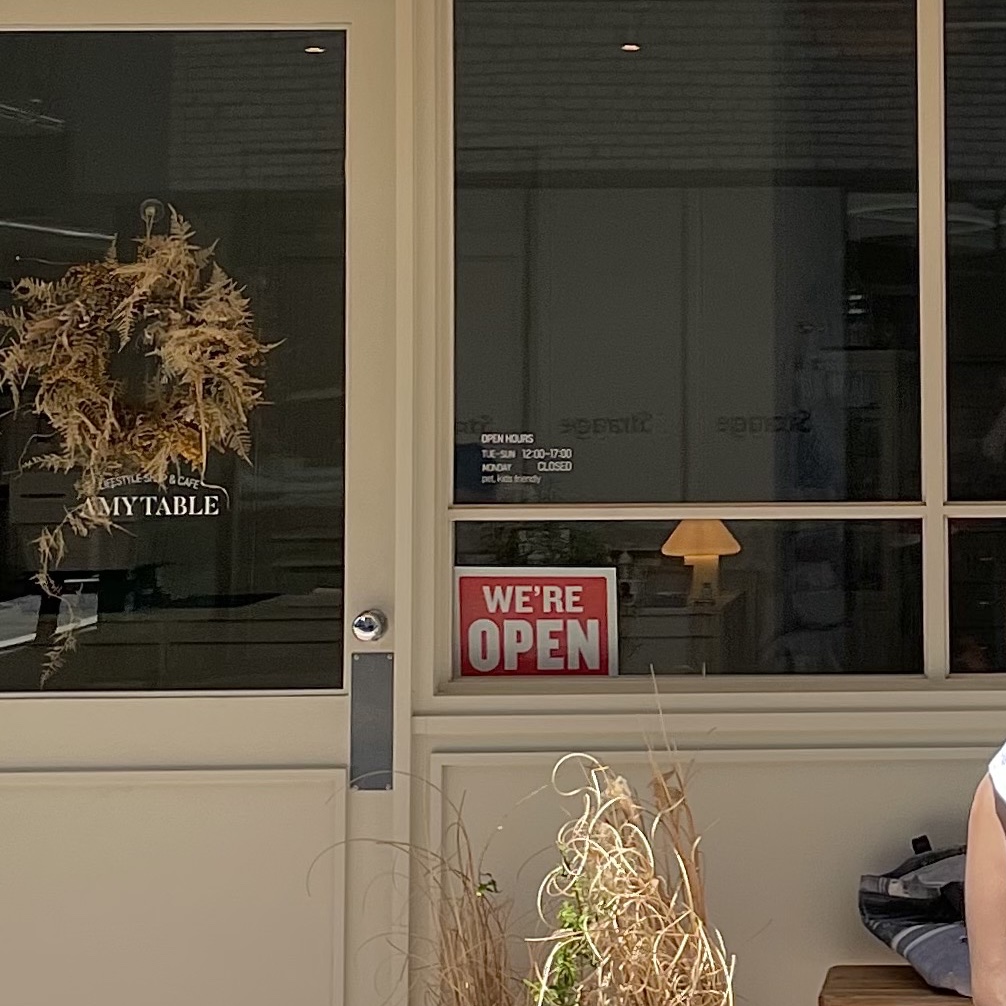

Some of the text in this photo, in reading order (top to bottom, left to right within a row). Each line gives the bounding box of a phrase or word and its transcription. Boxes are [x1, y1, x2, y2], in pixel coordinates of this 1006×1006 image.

[481, 433, 534, 444] OPEN HOURS
[481, 448, 573, 459] TUE-SUN 12:00-17:00
[481, 461, 573, 472] MONDAY CLOSED
[168, 473, 176, 485] &
[177, 475, 201, 490] CAFE
[482, 585, 584, 614] WE'RE
[468, 618, 600, 672] OPEN
